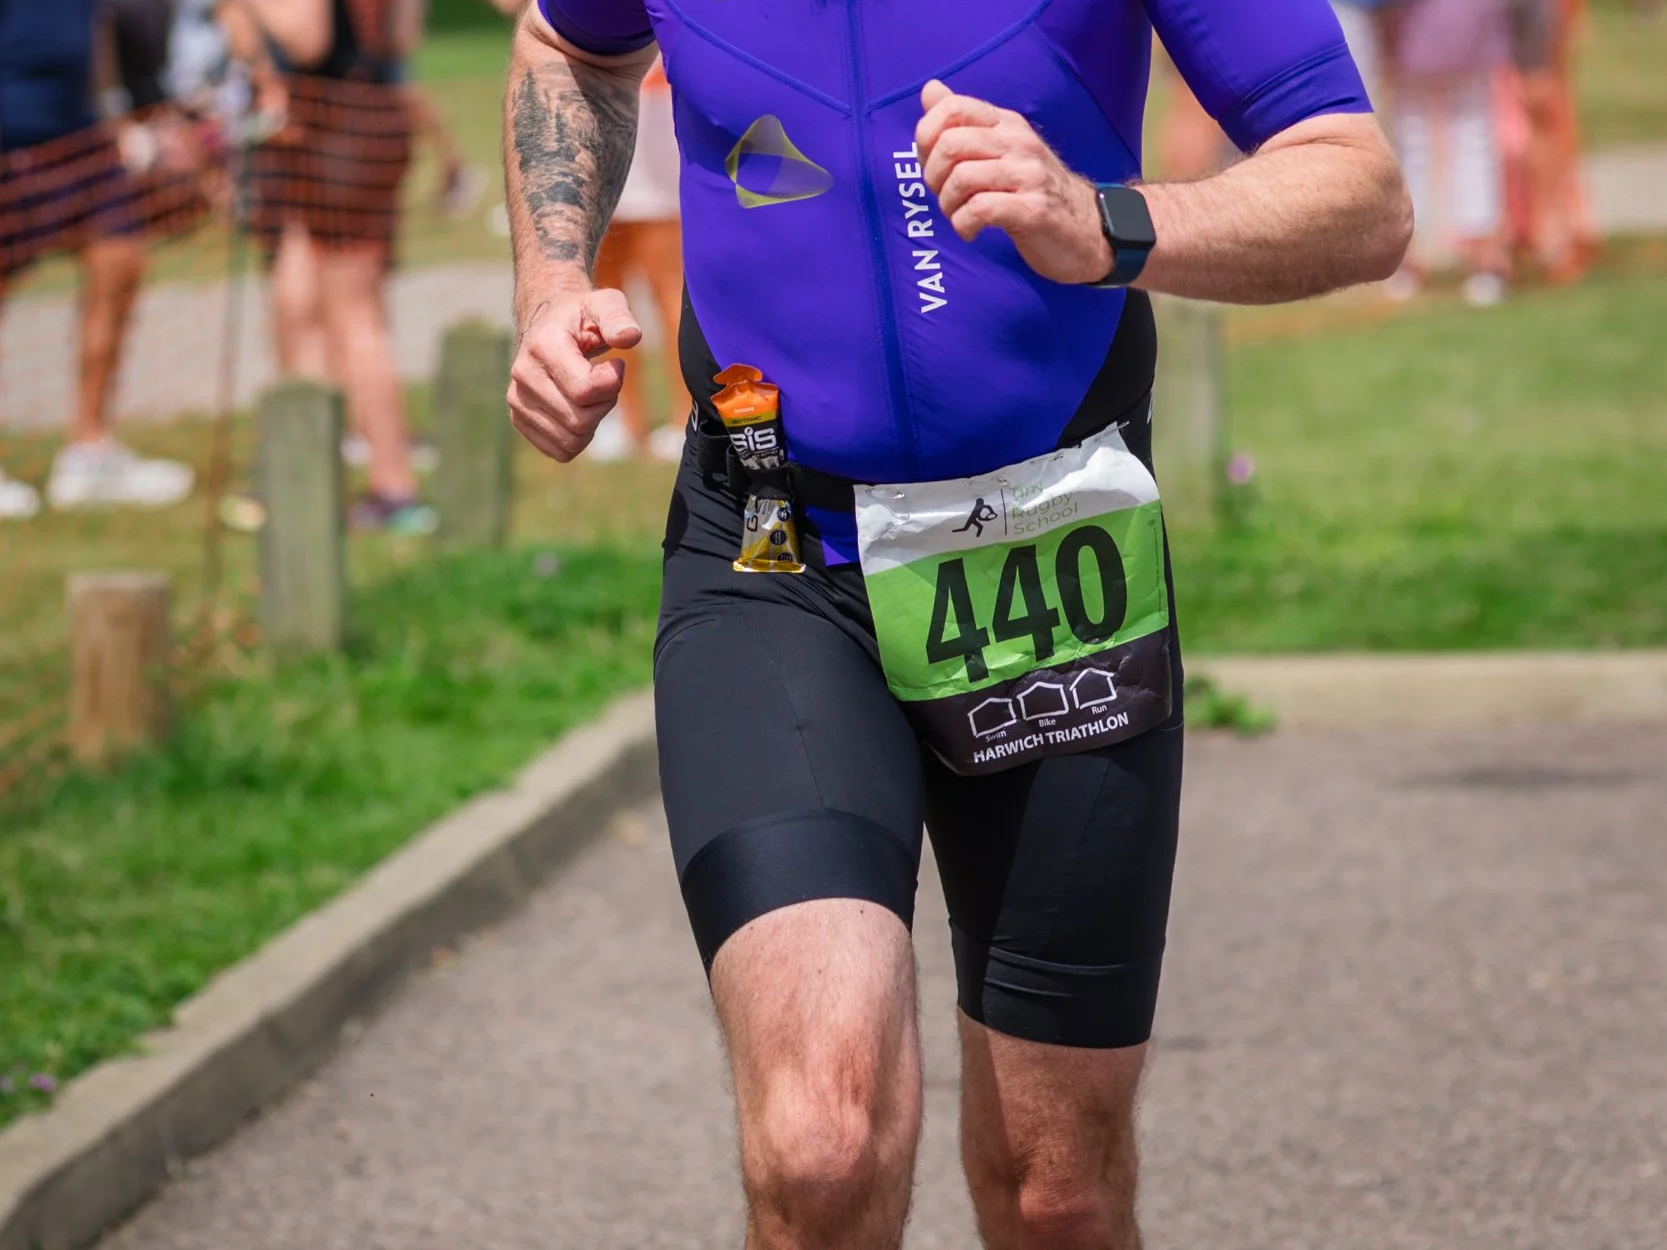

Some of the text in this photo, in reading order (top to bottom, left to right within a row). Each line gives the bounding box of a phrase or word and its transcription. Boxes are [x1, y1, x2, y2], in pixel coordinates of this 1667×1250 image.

[893, 142, 947, 313] VAN RYSEL
[1012, 492, 1072, 519] Rugby
[1014, 502, 1078, 534] School
[926, 525, 1127, 683] 440
[1038, 718, 1056, 728] Bike
[1091, 704, 1107, 715] Run
[974, 711, 1129, 764] HARWICH TRIATHLON
[985, 729, 1007, 743] Swim
